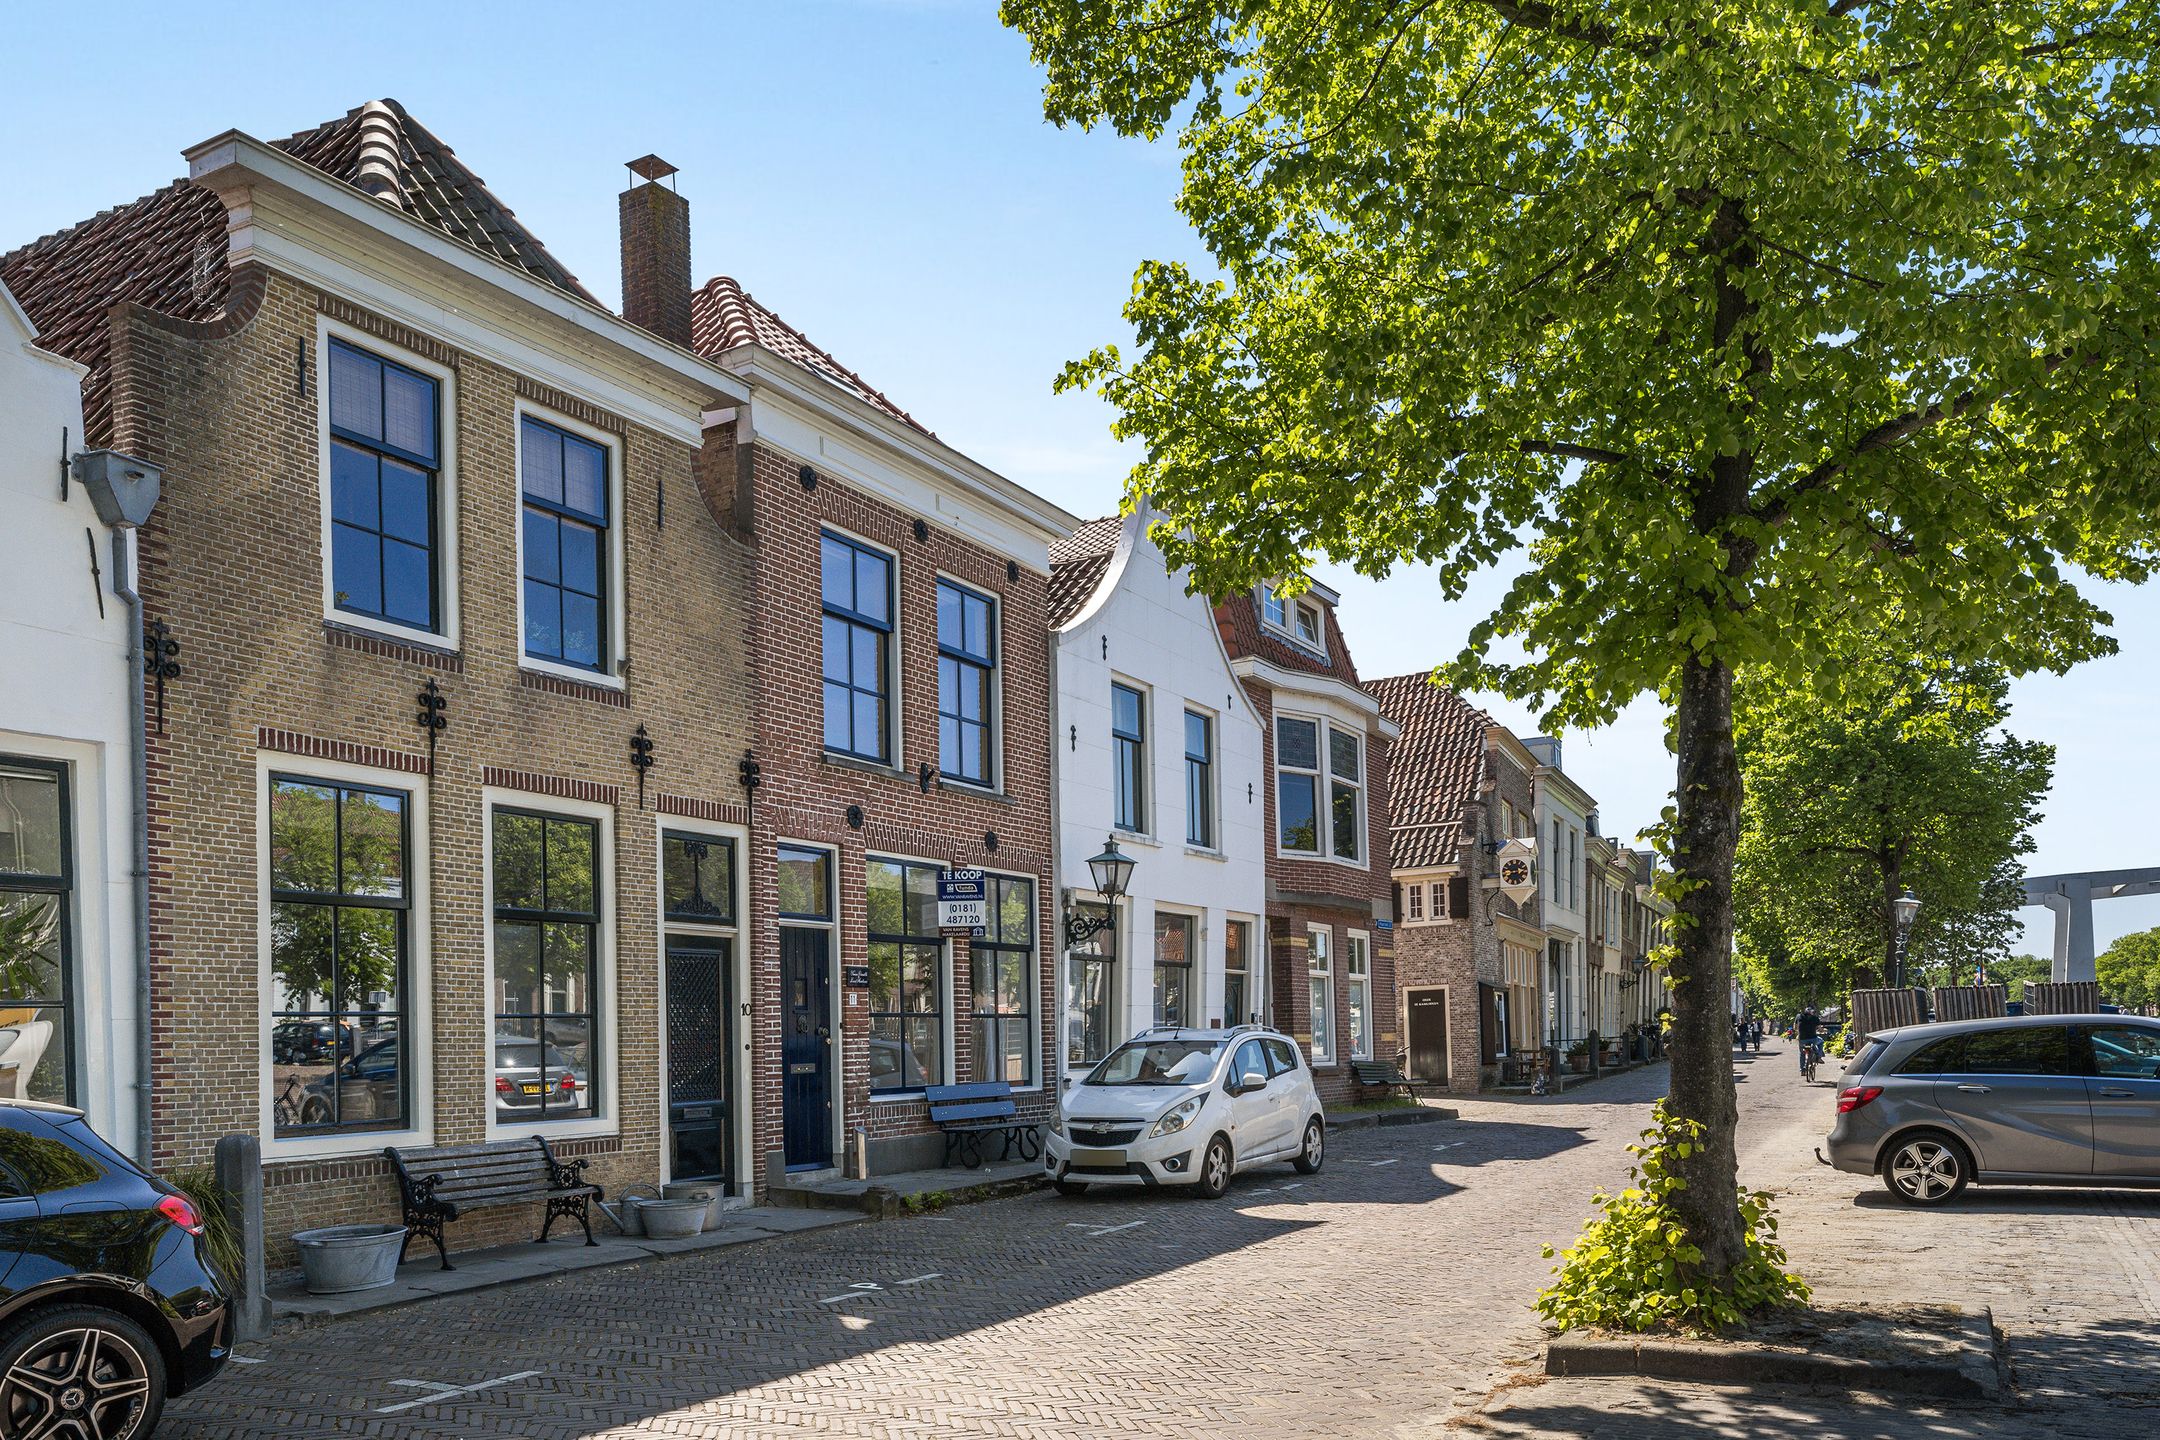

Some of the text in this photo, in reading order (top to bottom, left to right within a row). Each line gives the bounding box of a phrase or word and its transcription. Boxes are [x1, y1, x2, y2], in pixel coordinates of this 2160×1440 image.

[942, 870, 982, 880] TE KOOP
[949, 903, 976, 914] (0181)
[946, 915, 980, 924] 487120
[741, 1003, 752, 1016] 10
